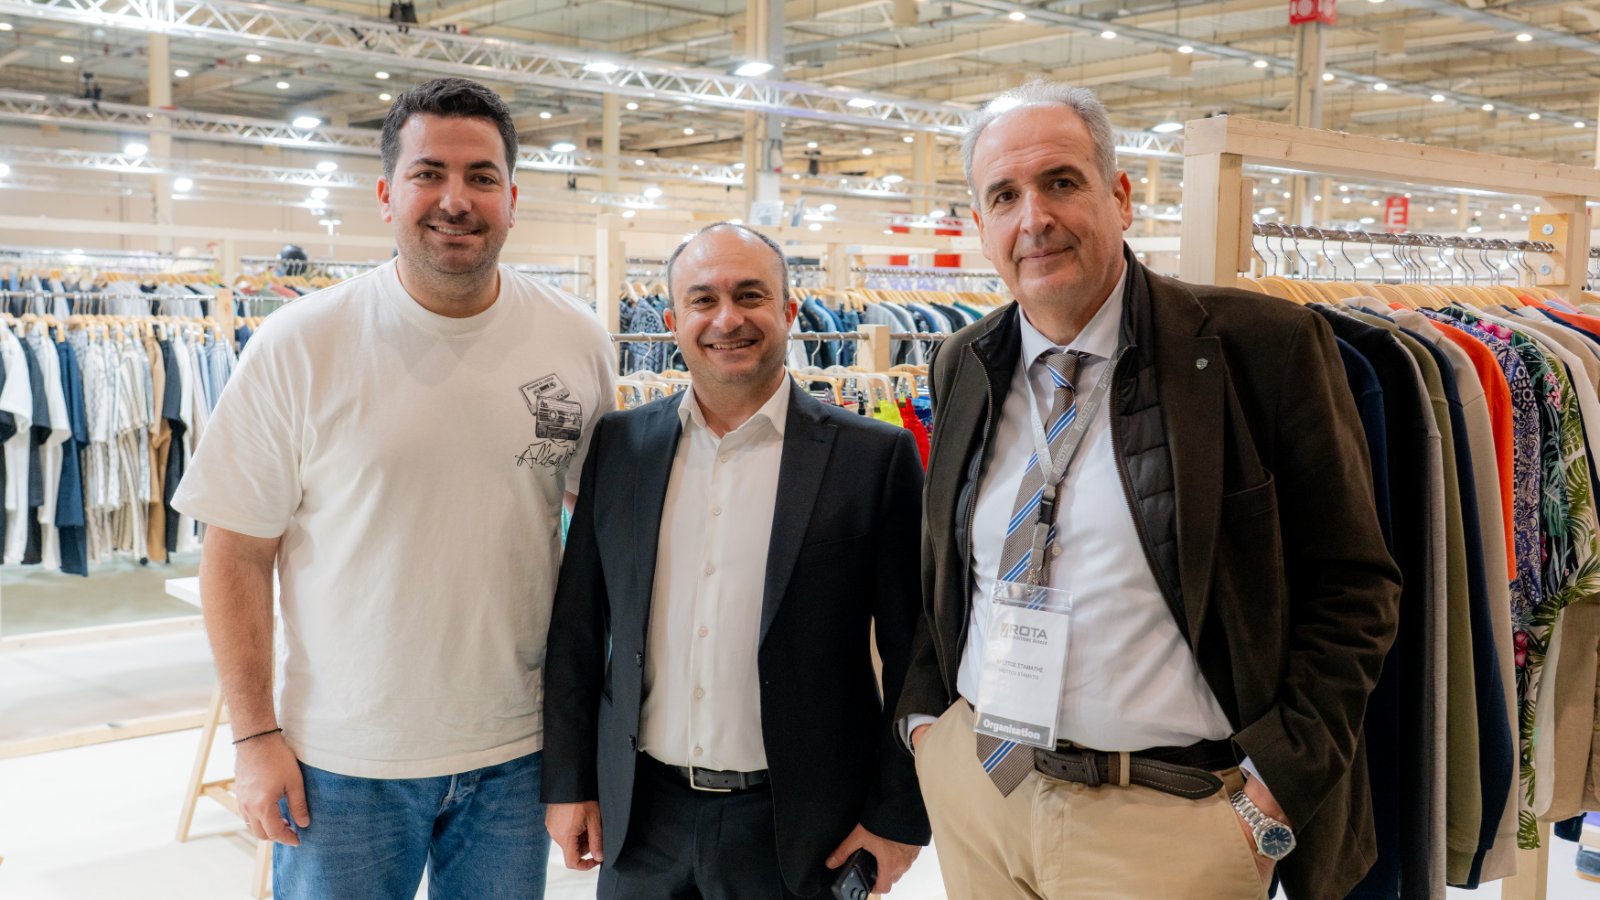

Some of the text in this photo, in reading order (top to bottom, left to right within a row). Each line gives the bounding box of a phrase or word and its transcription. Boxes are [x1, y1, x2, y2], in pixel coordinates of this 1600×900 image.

[1388, 207, 1406, 228] E
[1010, 624, 1048, 640] ROTA
[983, 718, 1040, 740] Organisation
